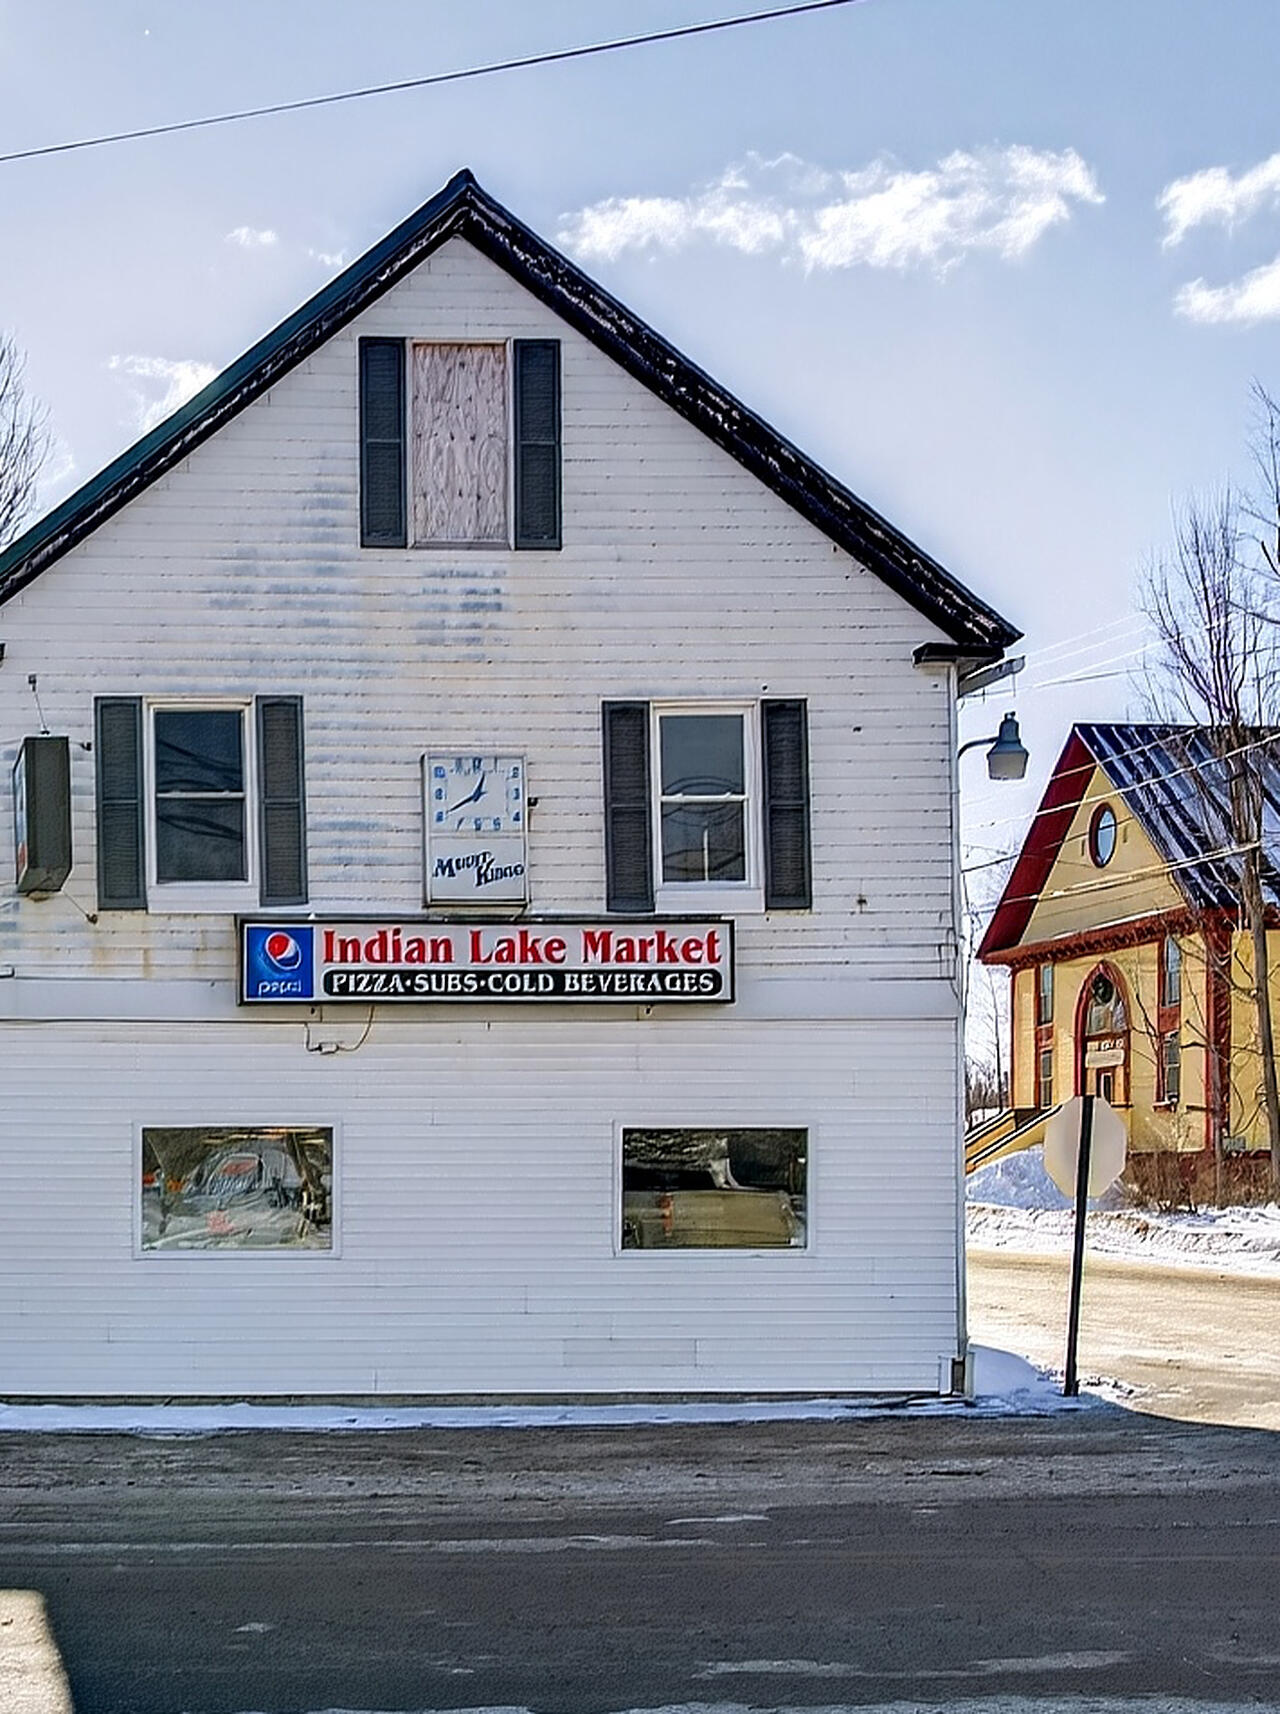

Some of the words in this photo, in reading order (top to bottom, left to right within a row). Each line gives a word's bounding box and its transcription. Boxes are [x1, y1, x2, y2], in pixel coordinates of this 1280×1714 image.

[323, 928, 455, 964] Indian
[468, 929, 567, 964] Lake
[582, 929, 722, 965] Market
[564, 972, 715, 993] BEVERAGES
